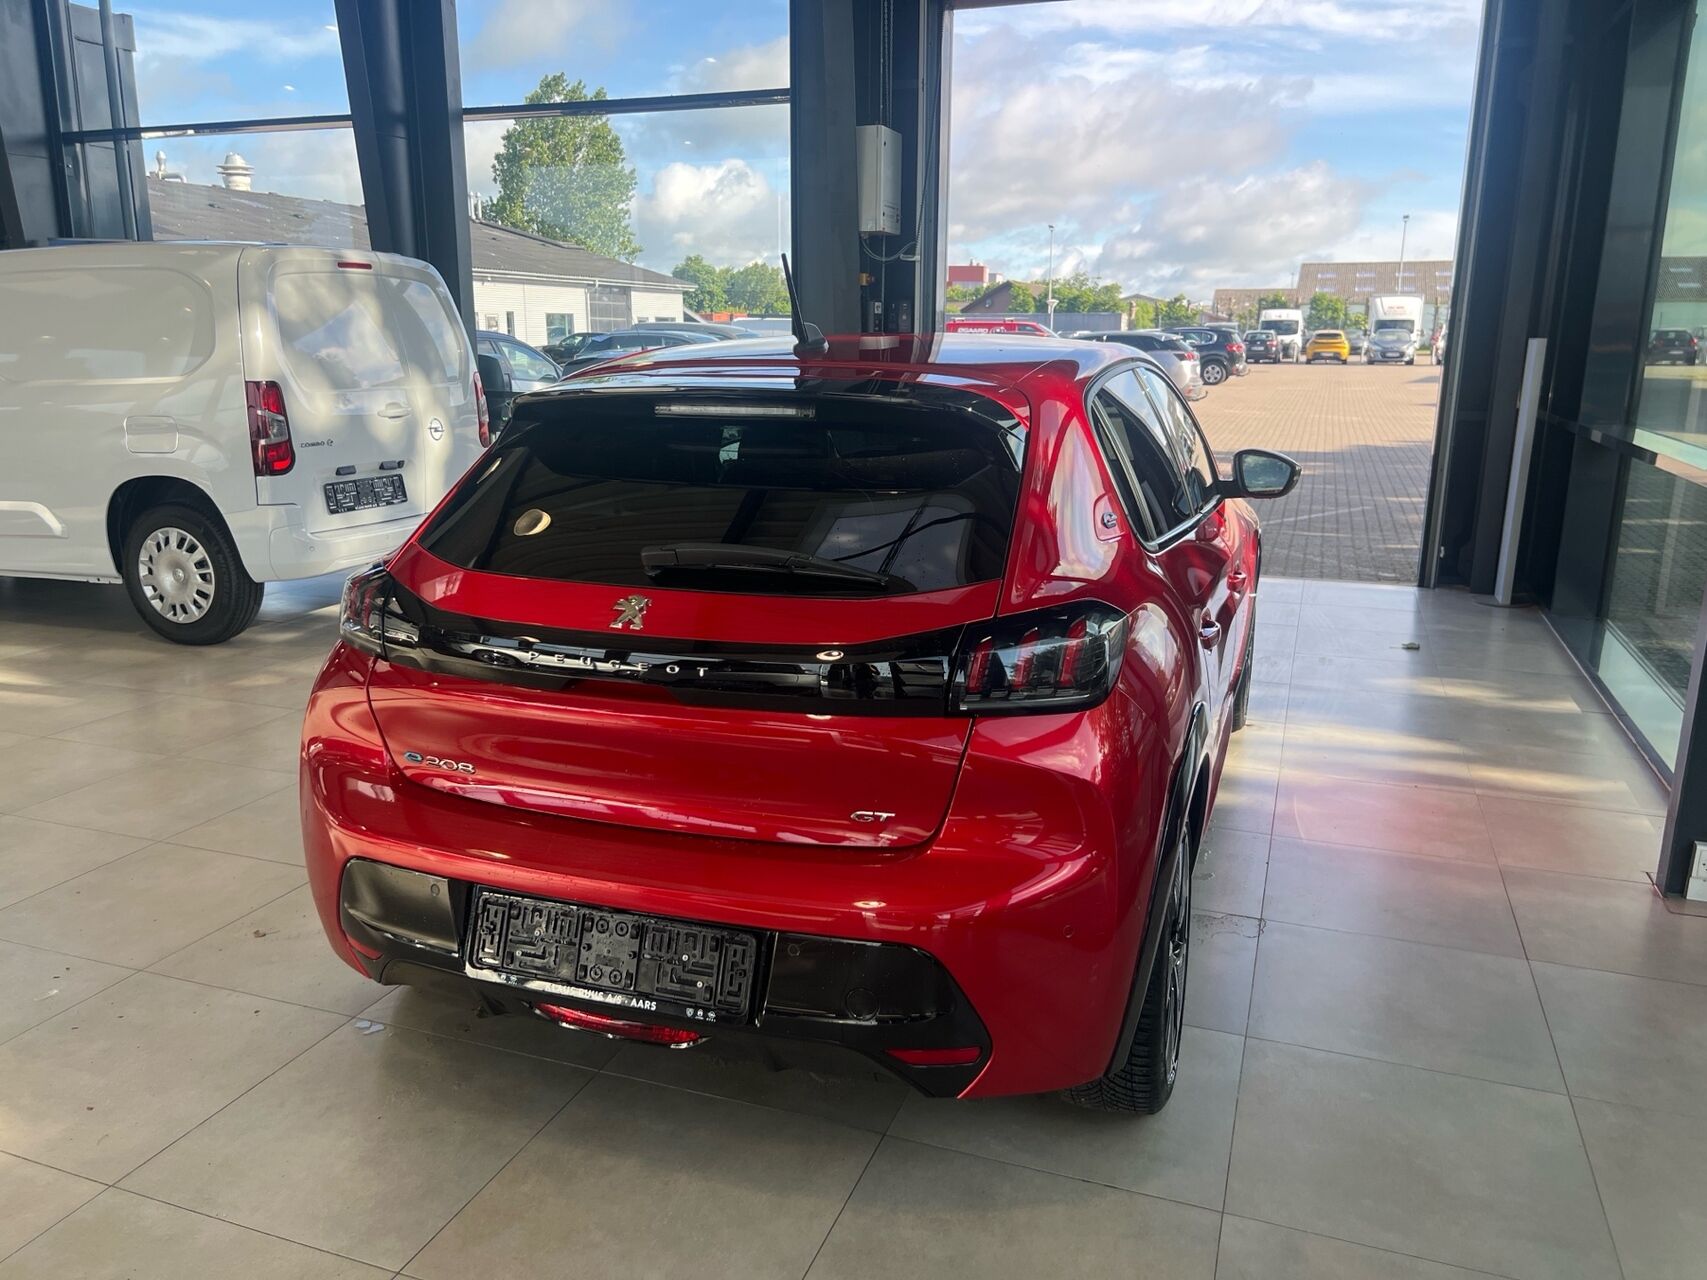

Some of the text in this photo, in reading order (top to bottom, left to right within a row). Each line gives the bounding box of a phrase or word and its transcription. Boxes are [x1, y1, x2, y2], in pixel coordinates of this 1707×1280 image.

[527, 650, 709, 678] PEUGEOT
[850, 810, 896, 822] GT
[605, 992, 623, 1005] A/S
[630, 998, 657, 1011] AARS
